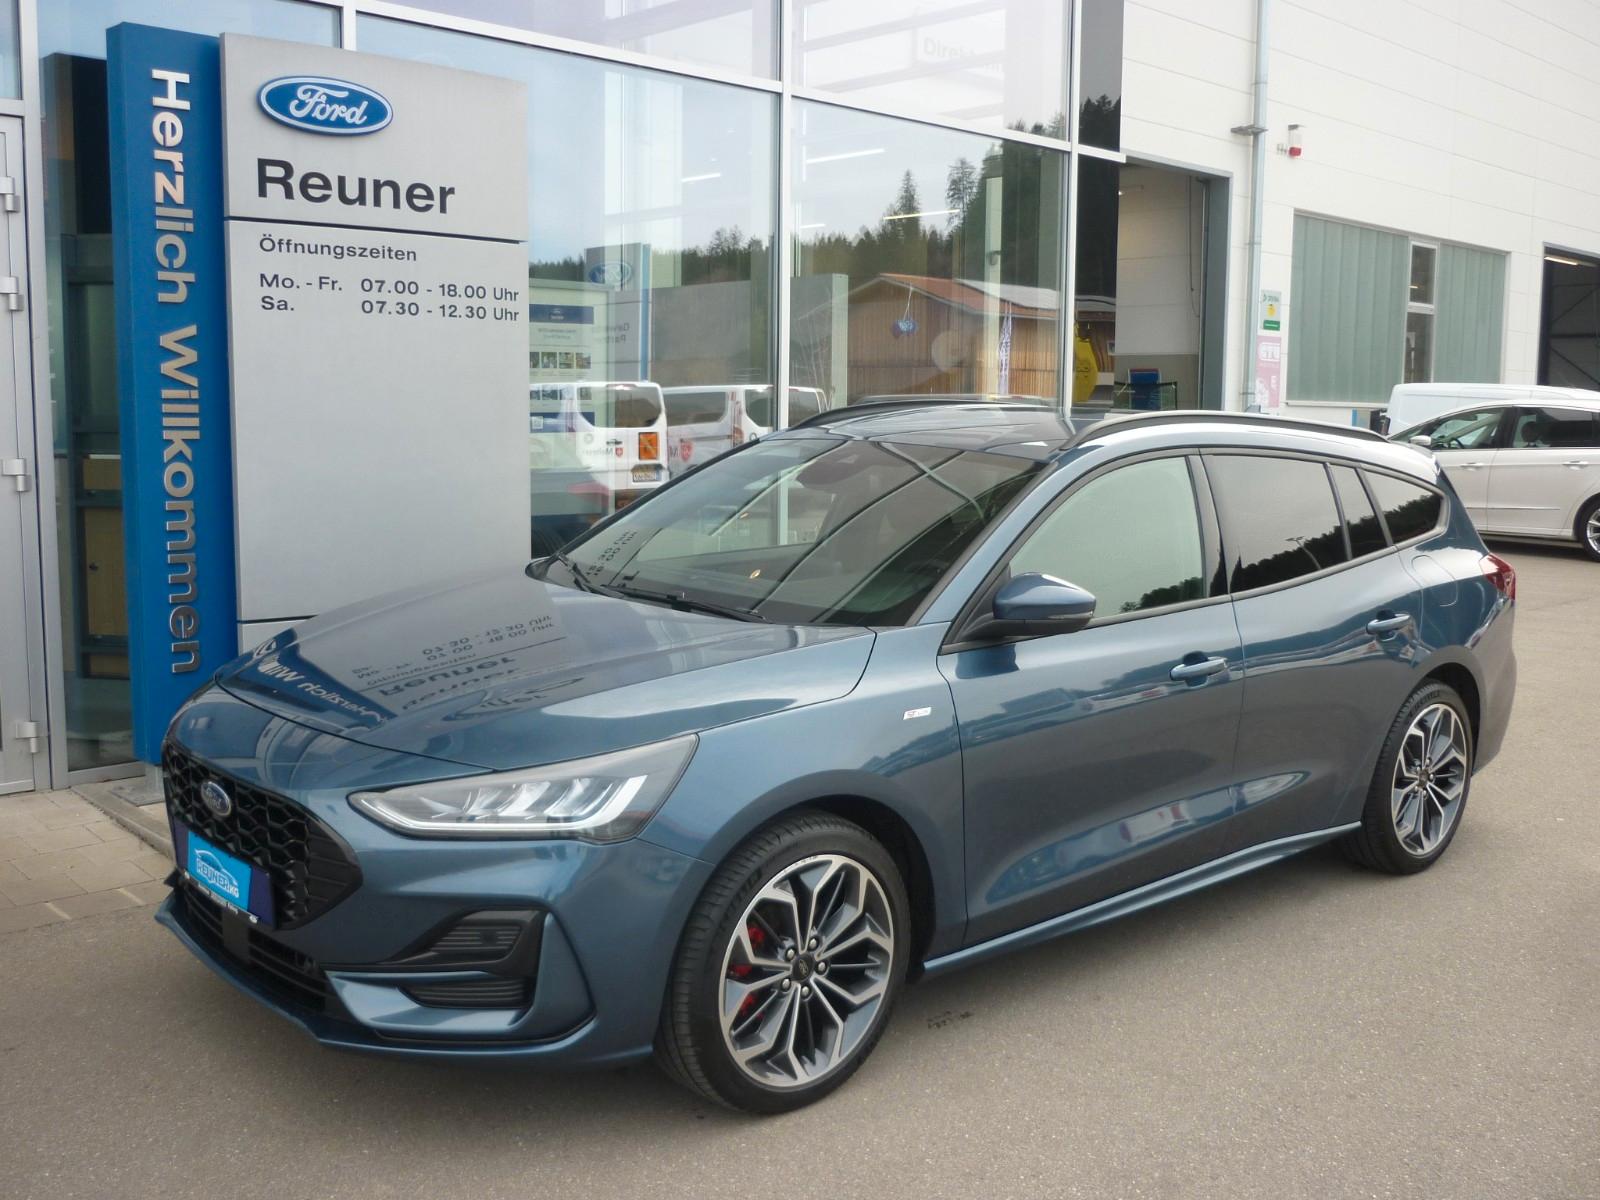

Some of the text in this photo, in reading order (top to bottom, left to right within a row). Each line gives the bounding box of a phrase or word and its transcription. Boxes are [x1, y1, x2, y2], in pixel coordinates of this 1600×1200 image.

[289, 84, 369, 125] Ford
[257, 157, 455, 214] Reuner
[259, 232, 417, 261] Öffnungszeiten
[259, 273, 300, 289] Mo.
[318, 276, 342, 291] Fr.
[361, 278, 419, 295] 07.00
[439, 284, 486, 299] 18.00
[493, 287, 519, 302] Uhr
[261, 296, 294, 311] Sa.
[361, 300, 419, 316] 07.30
[439, 304, 486, 319] 12.30
[493, 307, 519, 321] Uhr
[152, 69, 201, 673] Herzlich Willkommen
